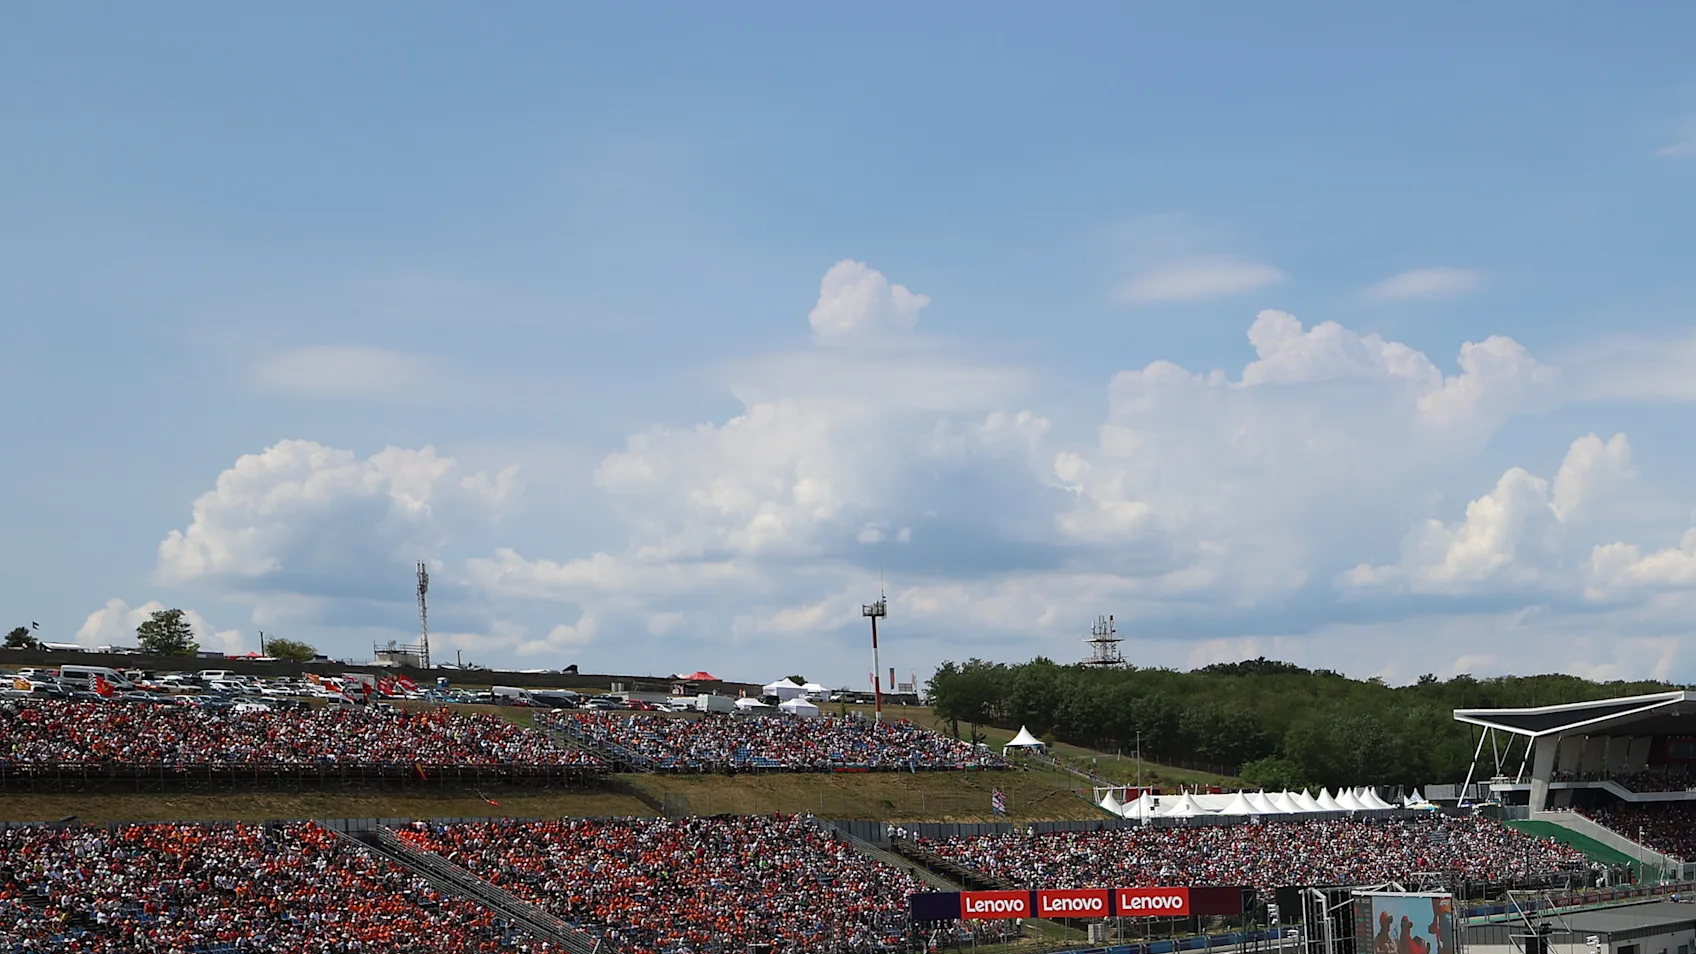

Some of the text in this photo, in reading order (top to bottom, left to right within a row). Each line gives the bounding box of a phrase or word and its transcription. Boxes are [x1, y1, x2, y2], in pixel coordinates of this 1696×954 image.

[966, 897, 1024, 912] Lenovo
[1043, 896, 1103, 911] Lenovo
[1121, 894, 1182, 910] Lenovo
